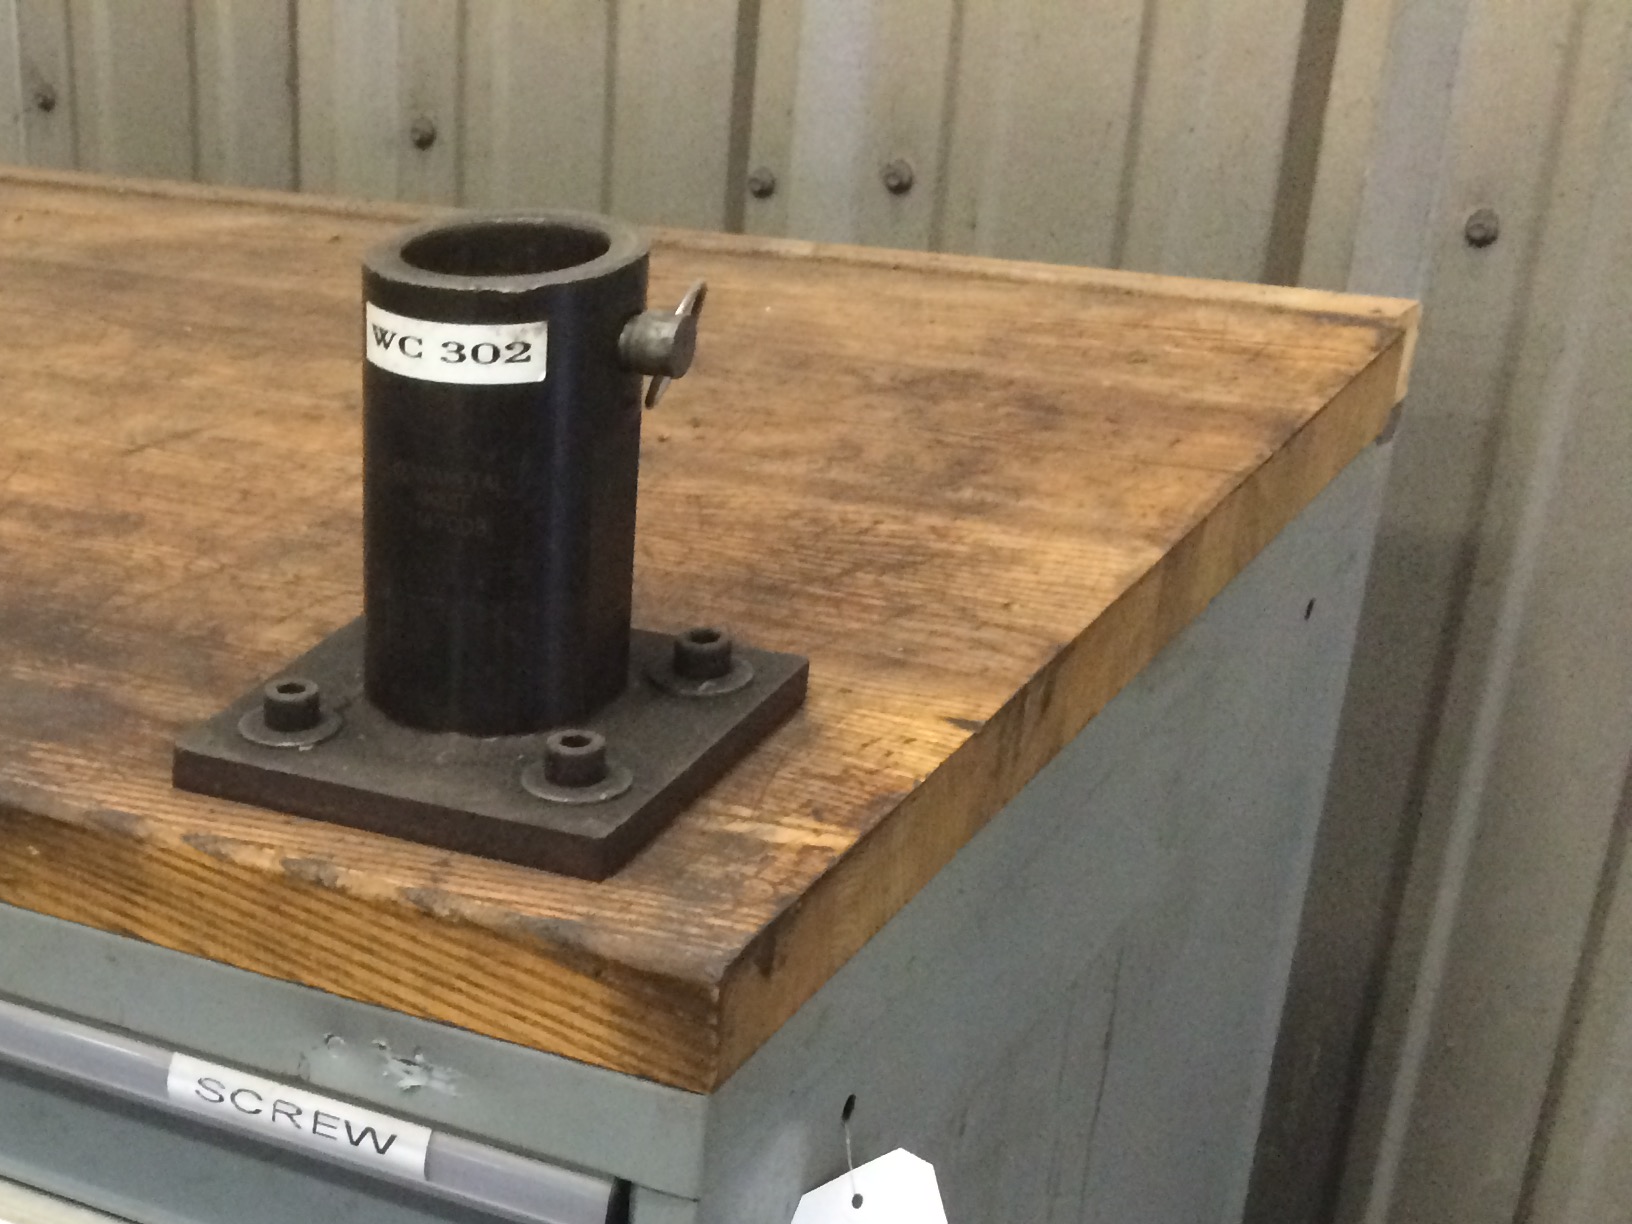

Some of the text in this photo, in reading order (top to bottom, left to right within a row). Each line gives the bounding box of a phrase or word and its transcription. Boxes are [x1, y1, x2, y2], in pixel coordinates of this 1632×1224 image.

[371, 324, 532, 365] WC 302
[194, 1077, 398, 1156] SCREW
